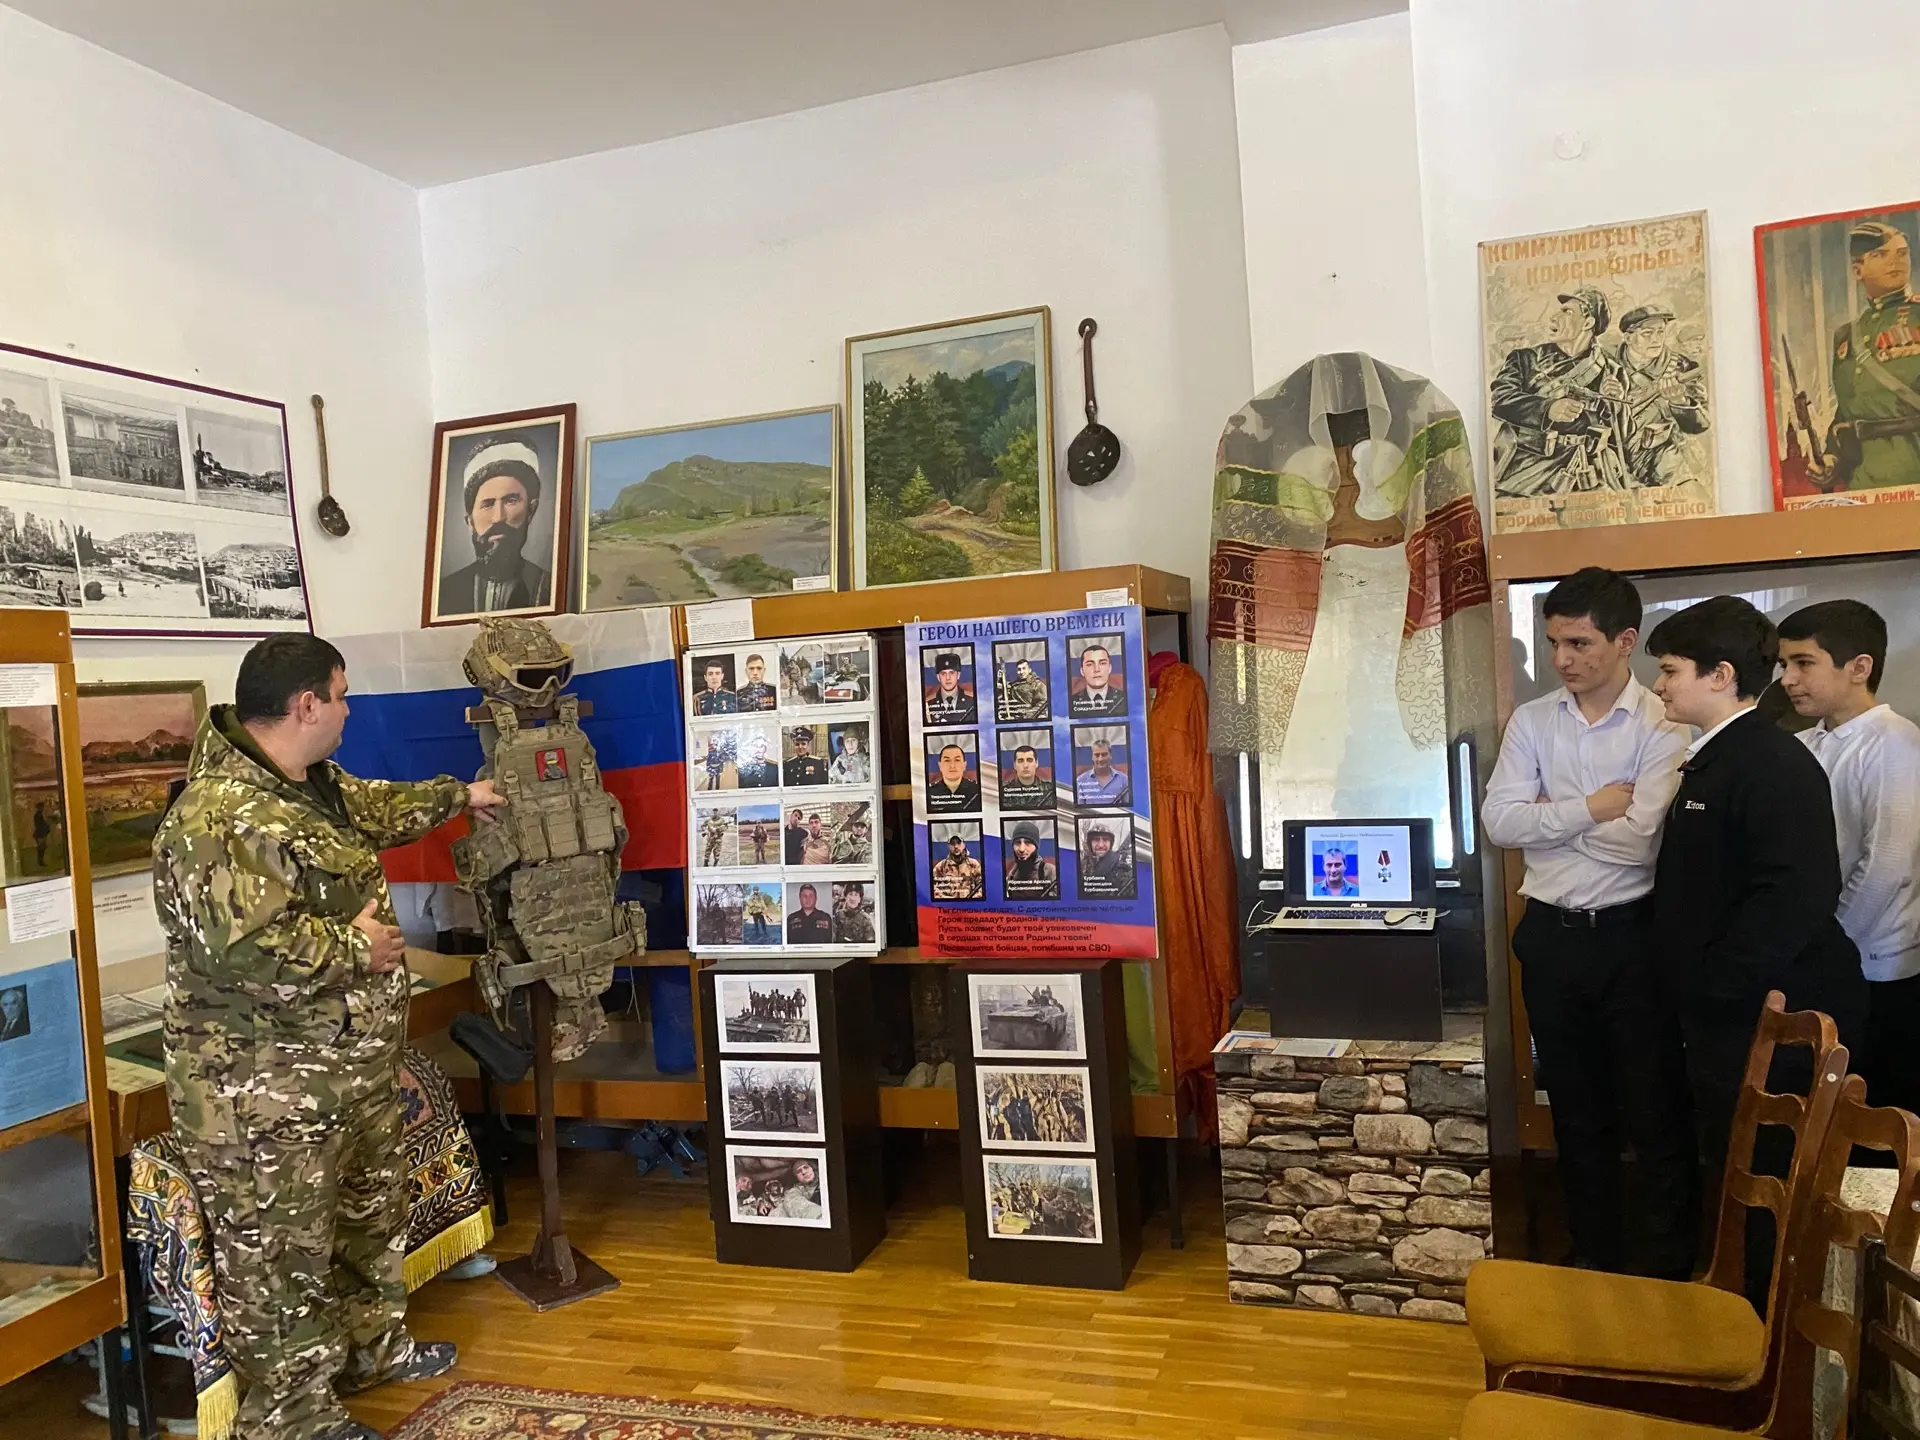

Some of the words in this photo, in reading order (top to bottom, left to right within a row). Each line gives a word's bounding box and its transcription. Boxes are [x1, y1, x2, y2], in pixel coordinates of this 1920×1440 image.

[919, 624, 968, 641] ГЕРОИ
[973, 619, 1041, 637] НАШЕГО
[1045, 612, 1125, 631] ВРЕМЕНИ
[1017, 905, 1024, 913] С
[1006, 914, 1038, 924] родной
[938, 925, 963, 934] Пусть
[964, 925, 994, 933] подвиг
[996, 924, 1021, 933] будет
[1023, 924, 1043, 932] твой
[1046, 925, 1097, 933] увековечен
[947, 935, 982, 943] сердцах
[1026, 933, 1061, 942] Родины
[1063, 933, 1092, 941] твоей!
[996, 943, 1029, 953] бойцам,
[1031, 944, 1074, 953] погибшим
[1076, 944, 1087, 952] на
[1088, 943, 1111, 953] СВО)
